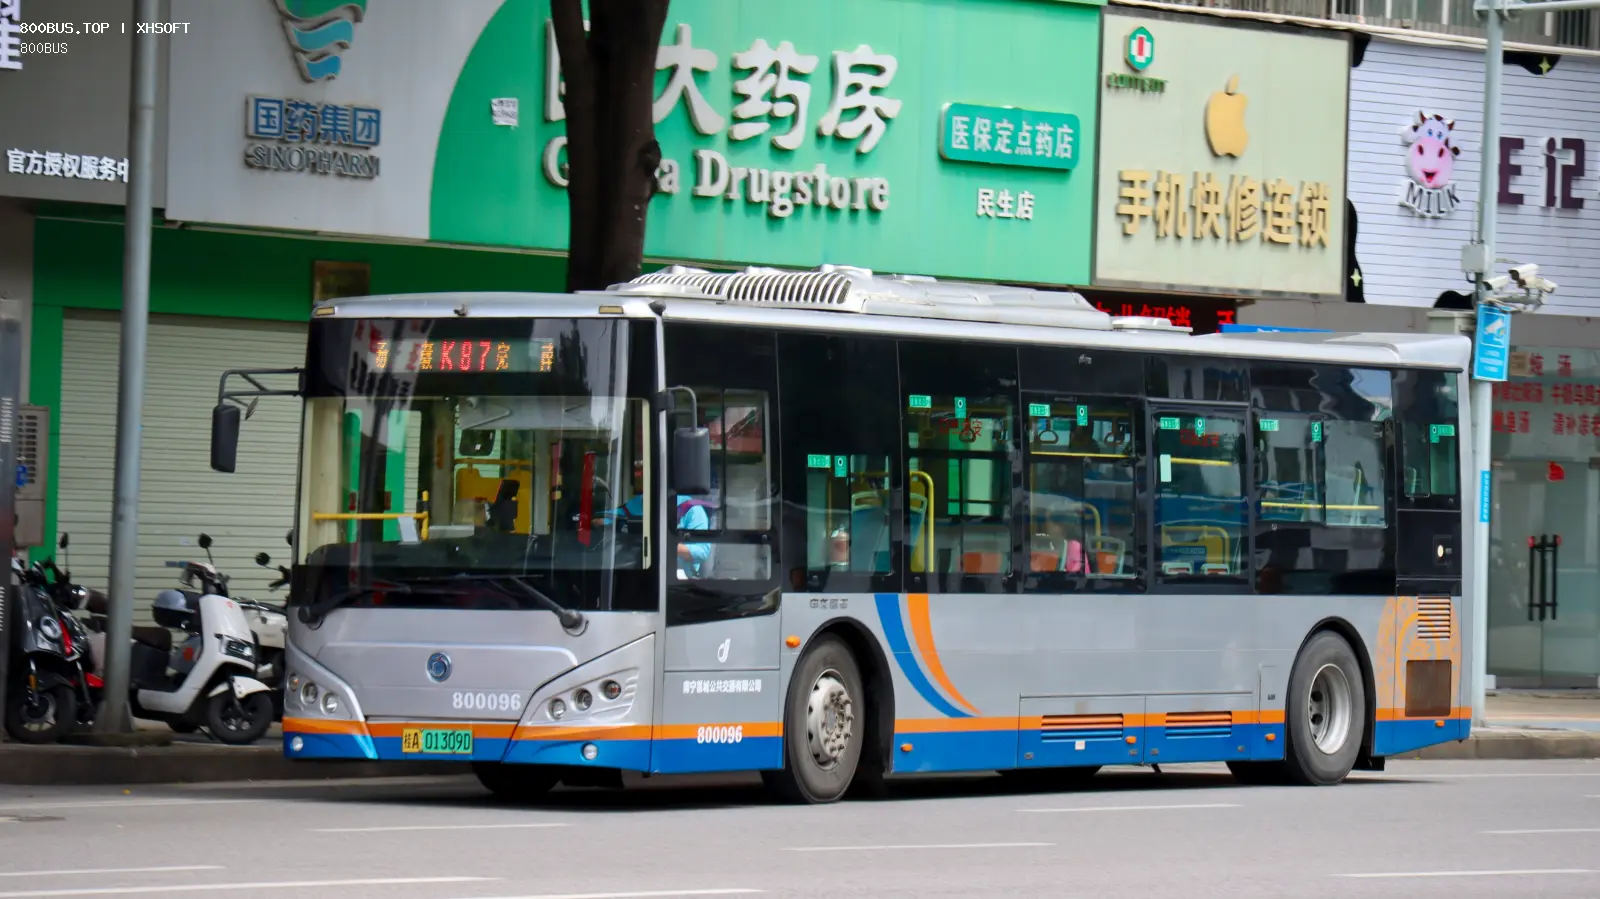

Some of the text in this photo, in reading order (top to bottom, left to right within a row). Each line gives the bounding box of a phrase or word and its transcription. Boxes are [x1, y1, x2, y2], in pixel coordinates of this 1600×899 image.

[545, 18, 903, 154] 大药房
[252, 97, 381, 146] 国药集团
[950, 115, 1075, 160] 医保定点药店
[250, 143, 381, 178] SINOPHARM
[692, 149, 890, 218] Drugstore
[1405, 181, 1461, 215] MILK
[976, 187, 1035, 221] 民生店
[1116, 170, 1331, 248] 手机快修连锁
[439, 339, 491, 371] K87
[452, 691, 522, 712] 800096
[696, 724, 744, 745] 800096
